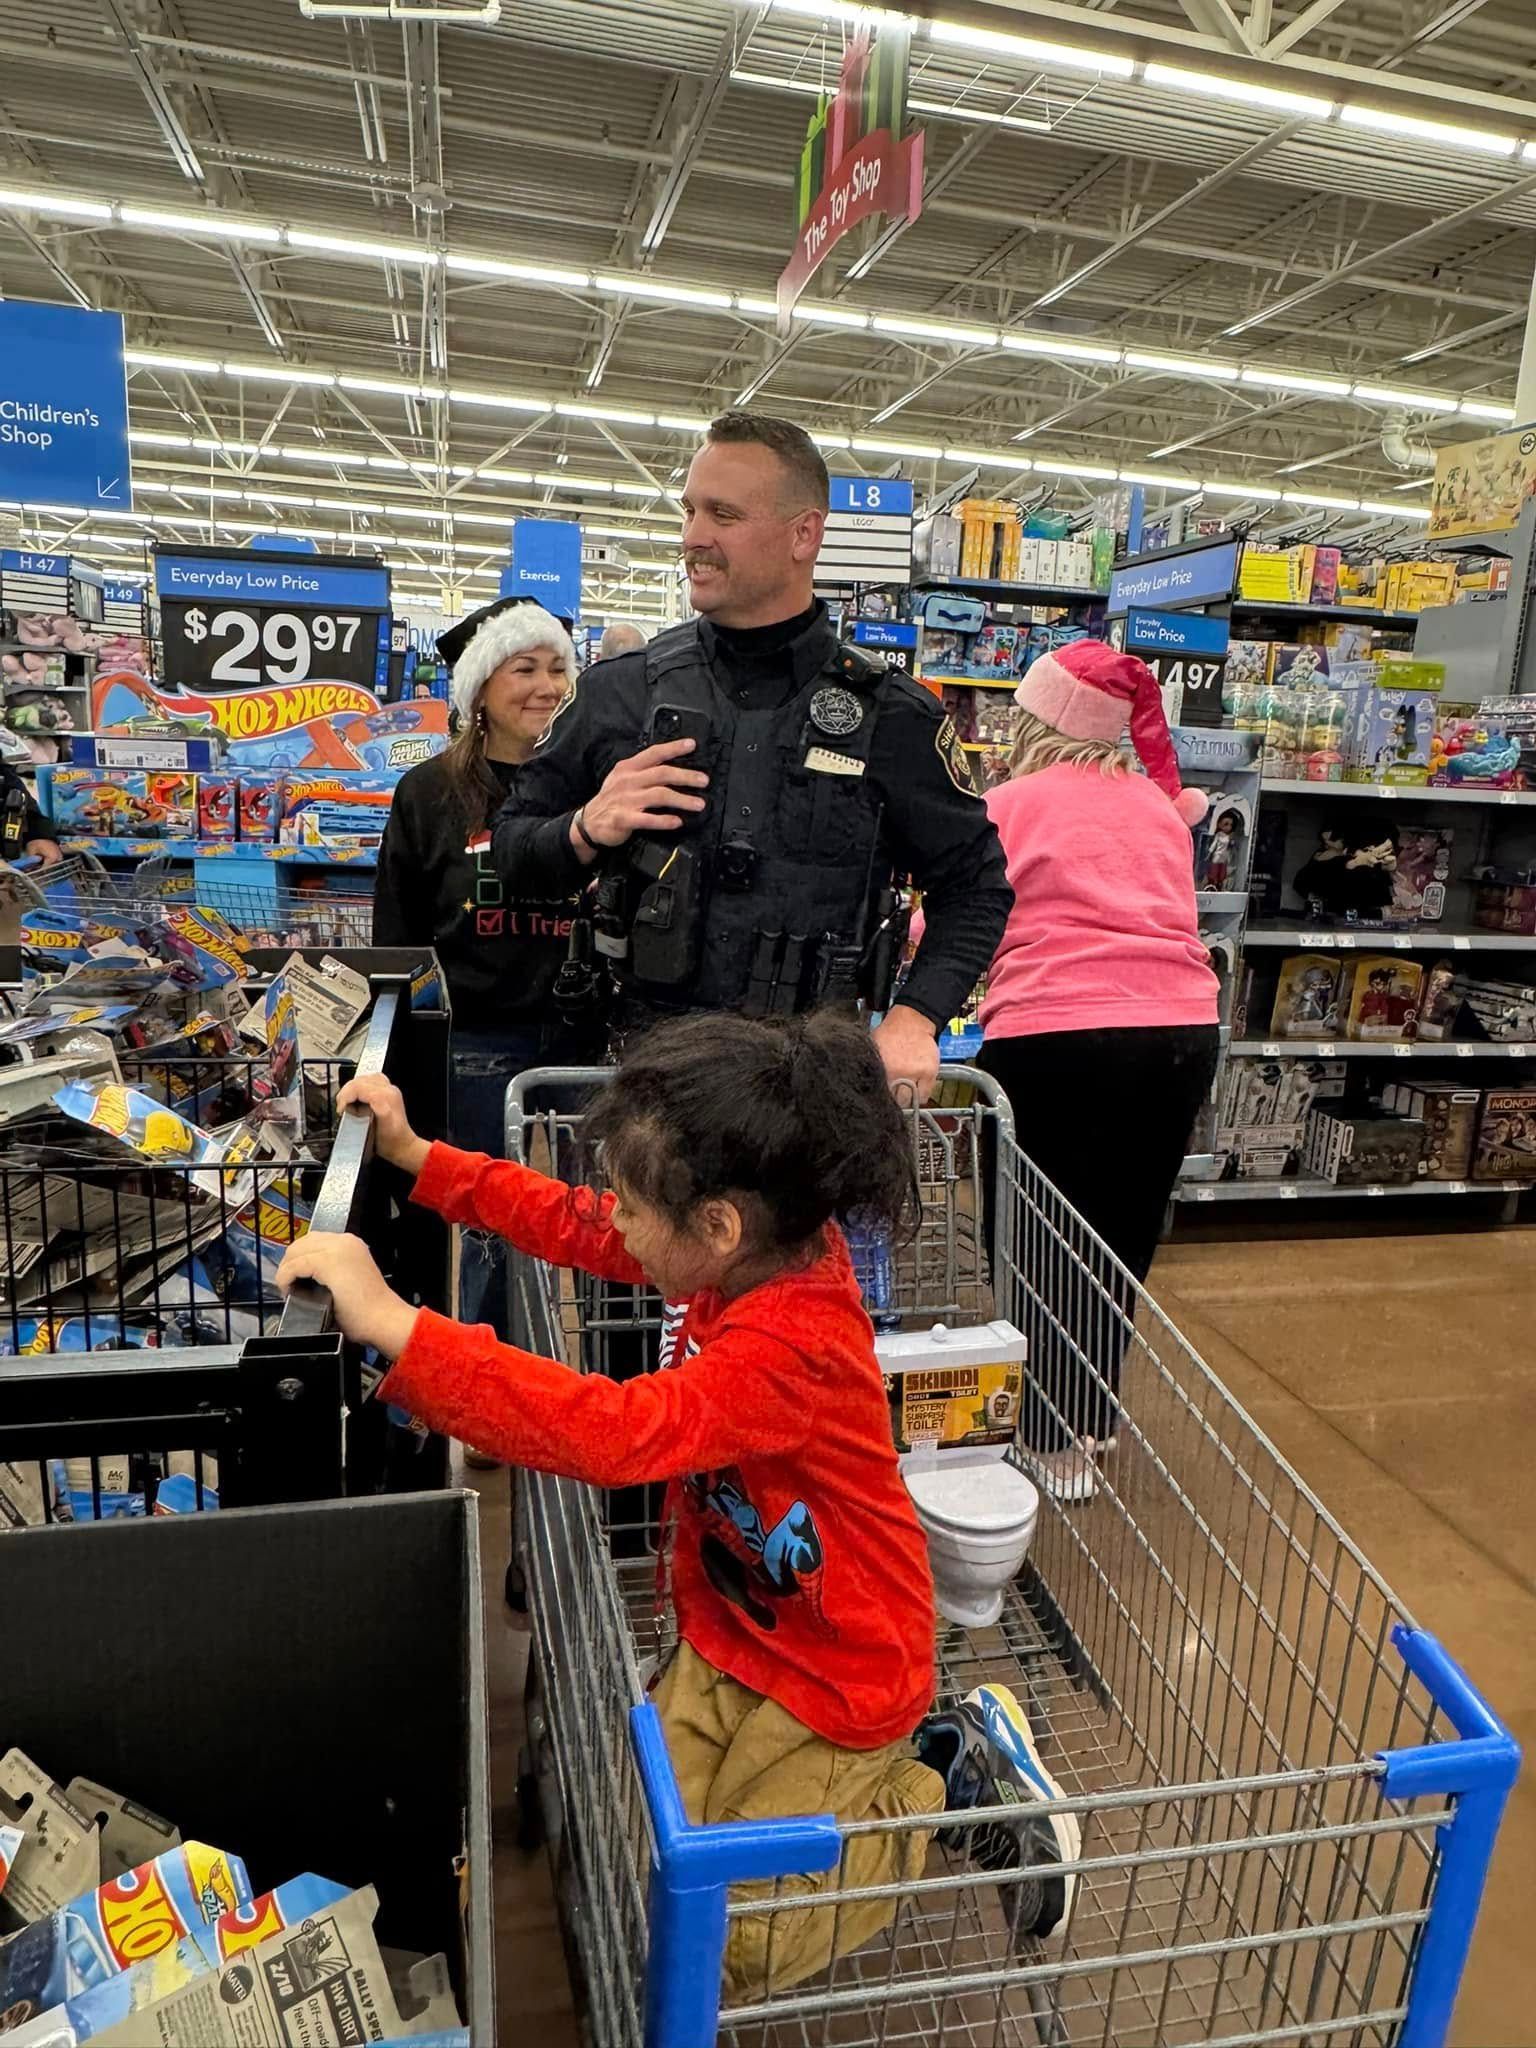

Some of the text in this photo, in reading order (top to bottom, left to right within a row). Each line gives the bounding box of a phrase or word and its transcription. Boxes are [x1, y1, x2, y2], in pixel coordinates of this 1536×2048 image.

[804, 156, 881, 262] The Toy Shop
[0, 401, 100, 426] Children's
[0, 424, 53, 451] Shop
[848, 484, 881, 508] L 8
[852, 518, 874, 527] LEGO
[19, 555, 56, 573] H 47
[171, 568, 320, 592] Everyday Low Price
[520, 569, 561, 583] Exercise
[1116, 569, 1193, 600] Everyday Low Price
[104, 588, 134, 602] H 49
[1135, 616, 1162, 629] Everyday
[865, 631, 898, 643] Low Price
[1135, 625, 1186, 643] Low Price
[527, 912, 572, 937] Trie
[905, 1411, 947, 1421] SURPRISE
[906, 1402, 947, 1413] MYSTERY
[906, 1419, 945, 1431] TOILET
[270, 1960, 295, 1998] 2/10
[352, 1968, 375, 2012] RALLY
[330, 1979, 360, 2042] HW DIRT
